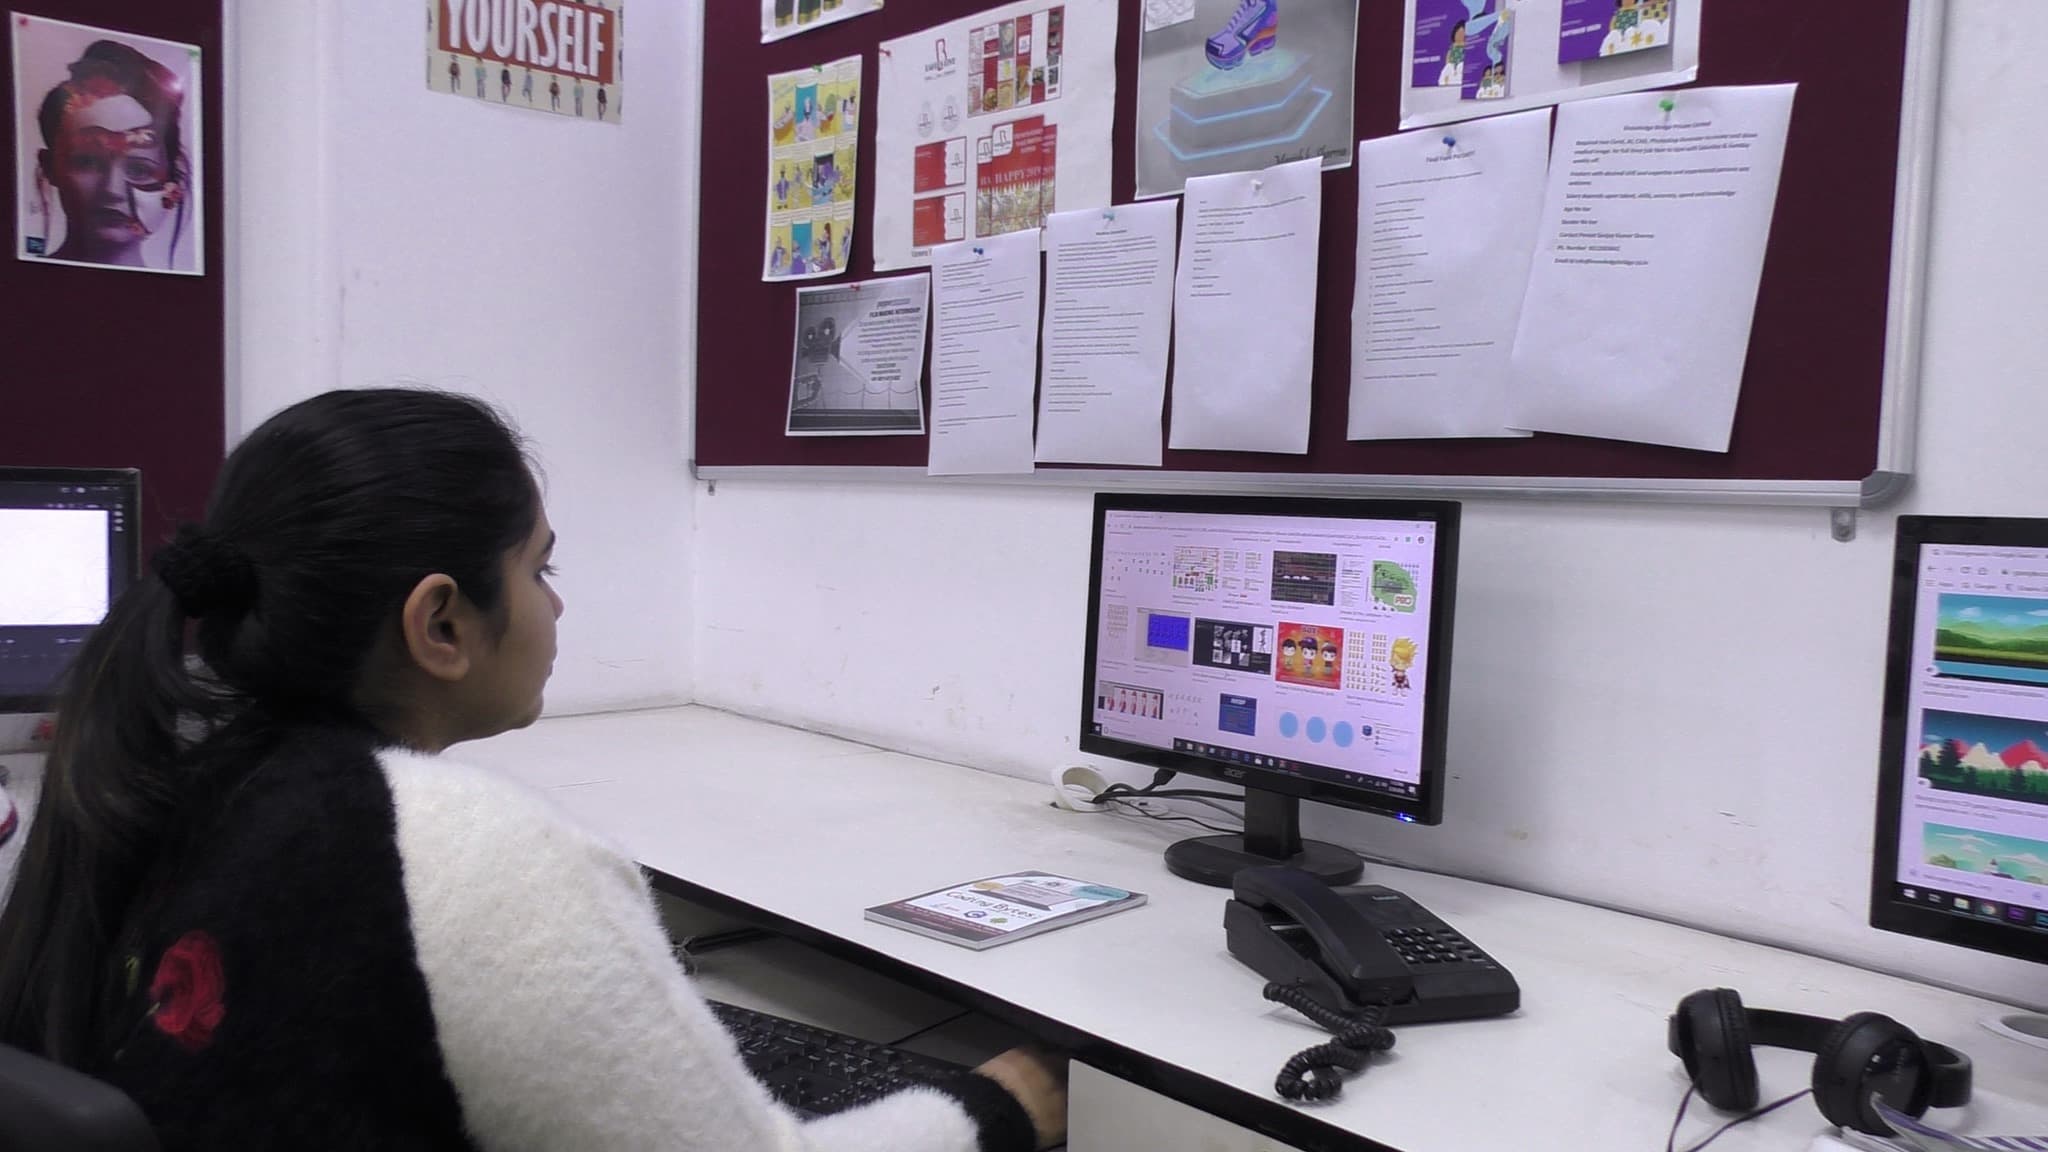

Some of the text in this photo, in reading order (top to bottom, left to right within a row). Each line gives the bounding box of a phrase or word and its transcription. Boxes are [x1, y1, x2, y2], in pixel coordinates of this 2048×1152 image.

[447, 0, 605, 77] YOURSELF
[994, 169, 1024, 184] HAPPY
[1224, 767, 1248, 778] acer
